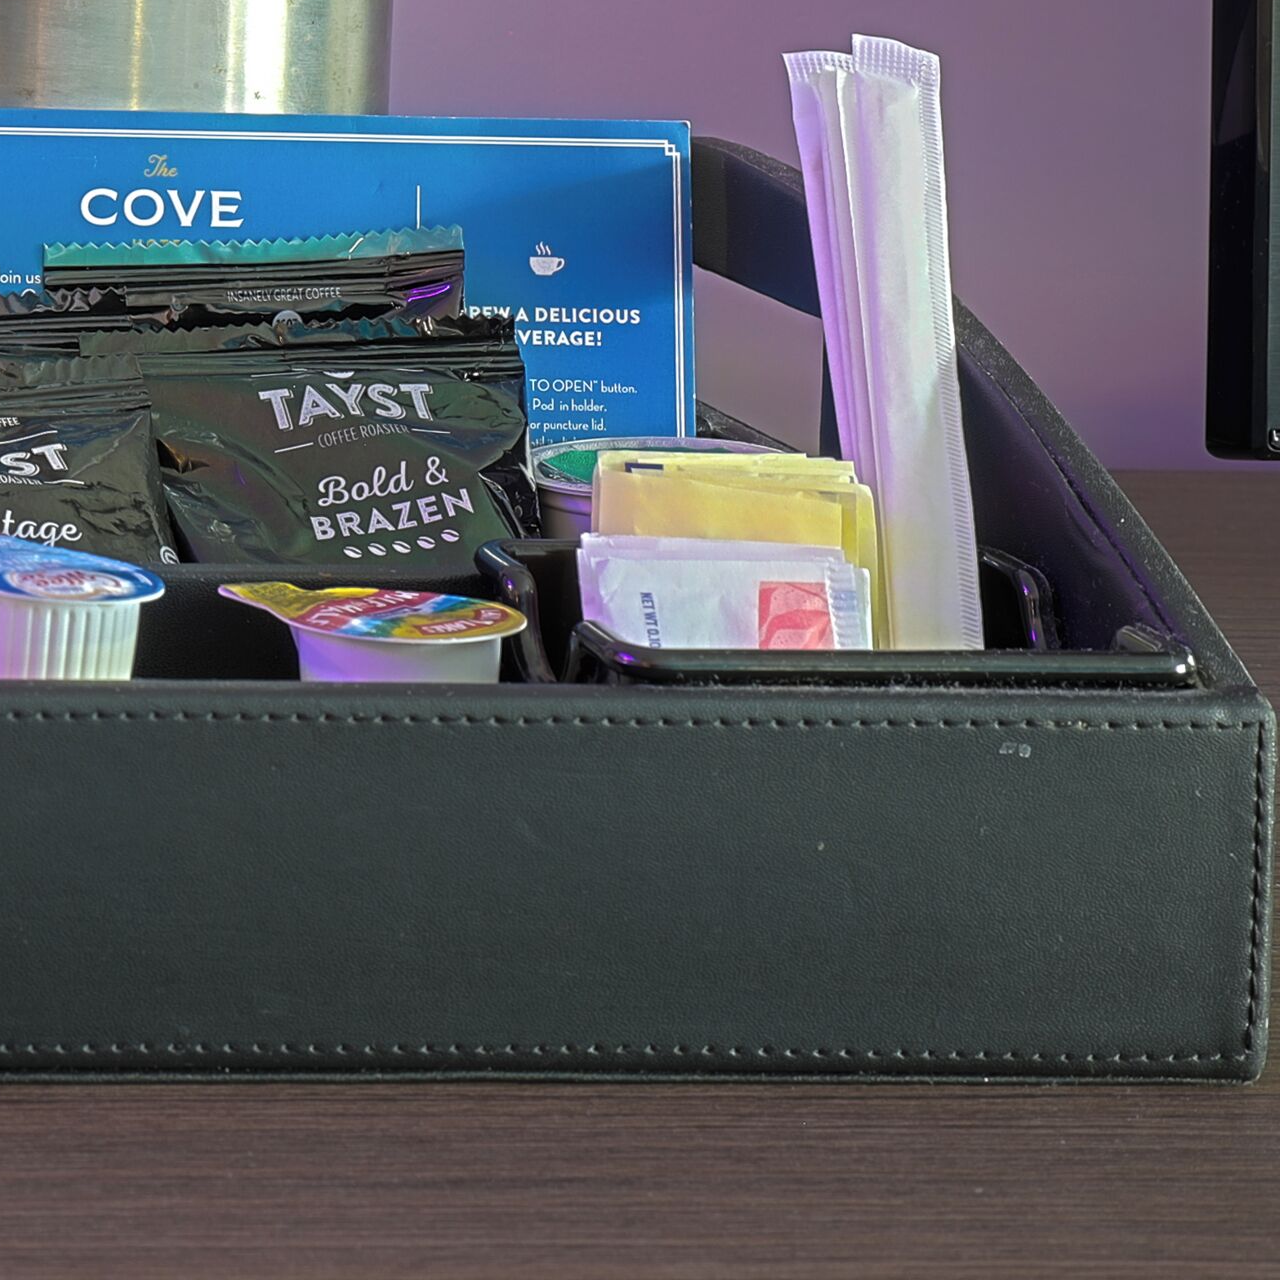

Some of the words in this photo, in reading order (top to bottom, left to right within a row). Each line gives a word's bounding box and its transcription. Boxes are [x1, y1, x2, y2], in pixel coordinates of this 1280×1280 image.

[143, 154, 179, 178] The
[80, 188, 245, 228] COVE
[25, 274, 42, 284] us
[227, 289, 272, 302] INSANELY
[273, 288, 303, 301] GREAT
[305, 287, 342, 300] COFFEE
[464, 306, 510, 320] REW
[514, 306, 529, 322] A
[535, 307, 641, 324] DELICIOUS
[516, 328, 602, 346] VERAGE!
[529, 379, 550, 392] TO
[601, 381, 638, 393] button.
[258, 383, 434, 432] TAYST
[532, 398, 554, 411] Pod
[559, 401, 569, 411] in
[571, 399, 607, 412] holder.
[543, 420, 589, 432] puncture
[591, 418, 607, 431] lid.
[318, 428, 359, 449] COFFEE
[360, 423, 410, 441] ROASTER
[317, 465, 414, 508] Bold
[424, 456, 450, 486] &
[310, 488, 475, 541] BRAZEN
[644, 612, 659, 627] WT
